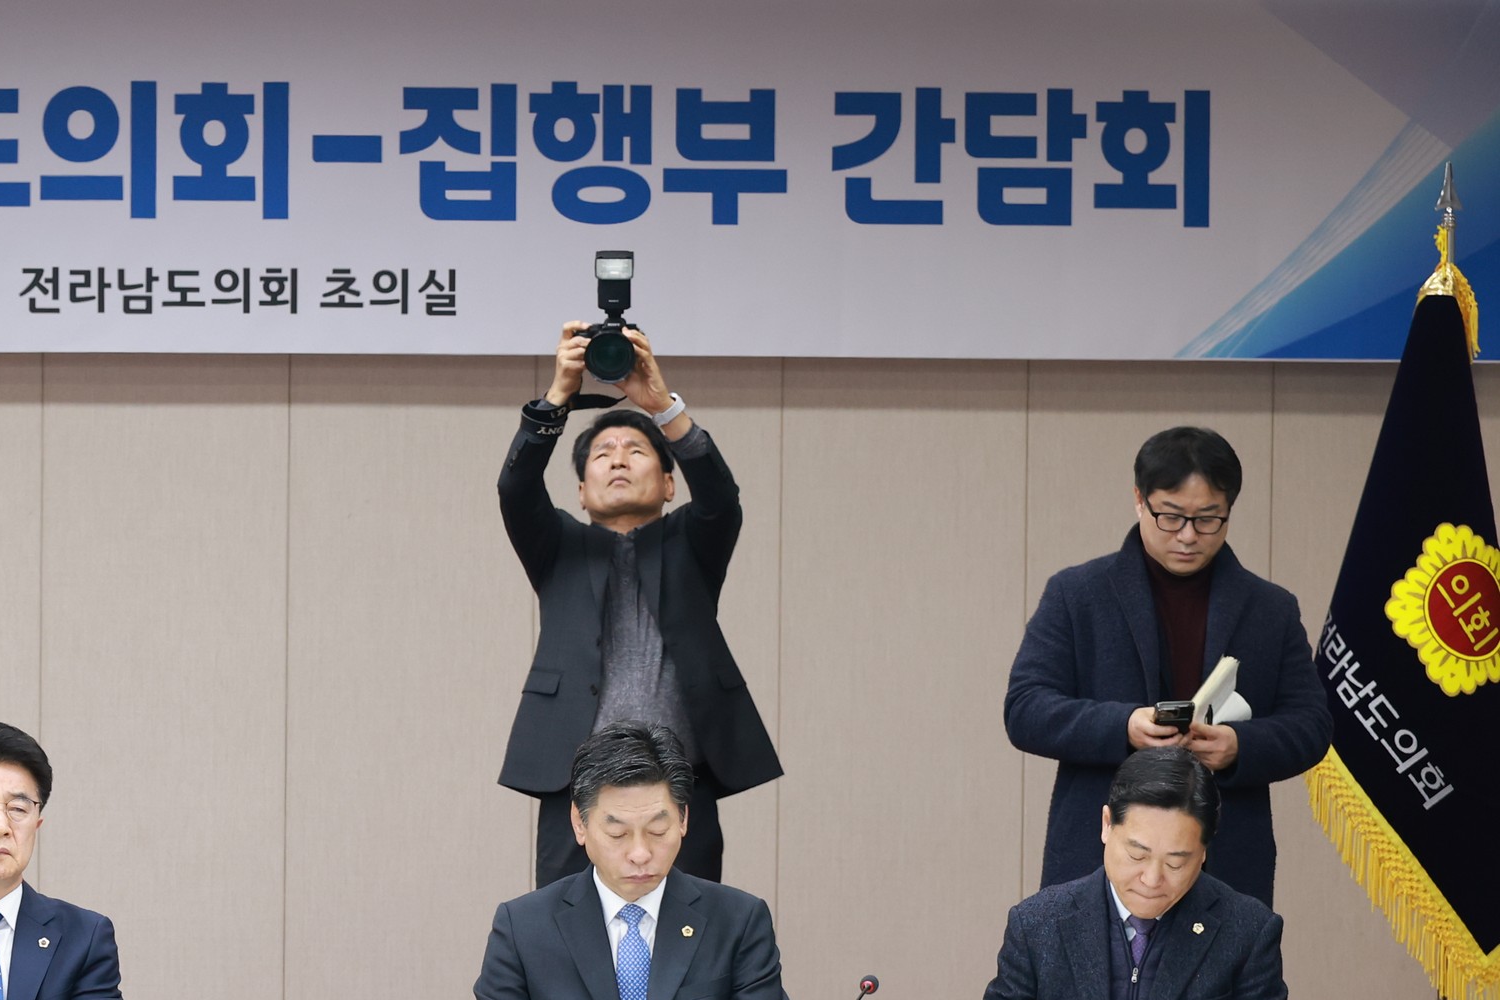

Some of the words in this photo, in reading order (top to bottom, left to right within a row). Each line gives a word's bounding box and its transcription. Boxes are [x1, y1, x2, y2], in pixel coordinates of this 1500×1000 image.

[831, 88, 1211, 228] 간담회
[18, 266, 300, 315] 전라남도의회
[319, 267, 457, 317] 초의실
[1436, 574, 1499, 652] 의회
